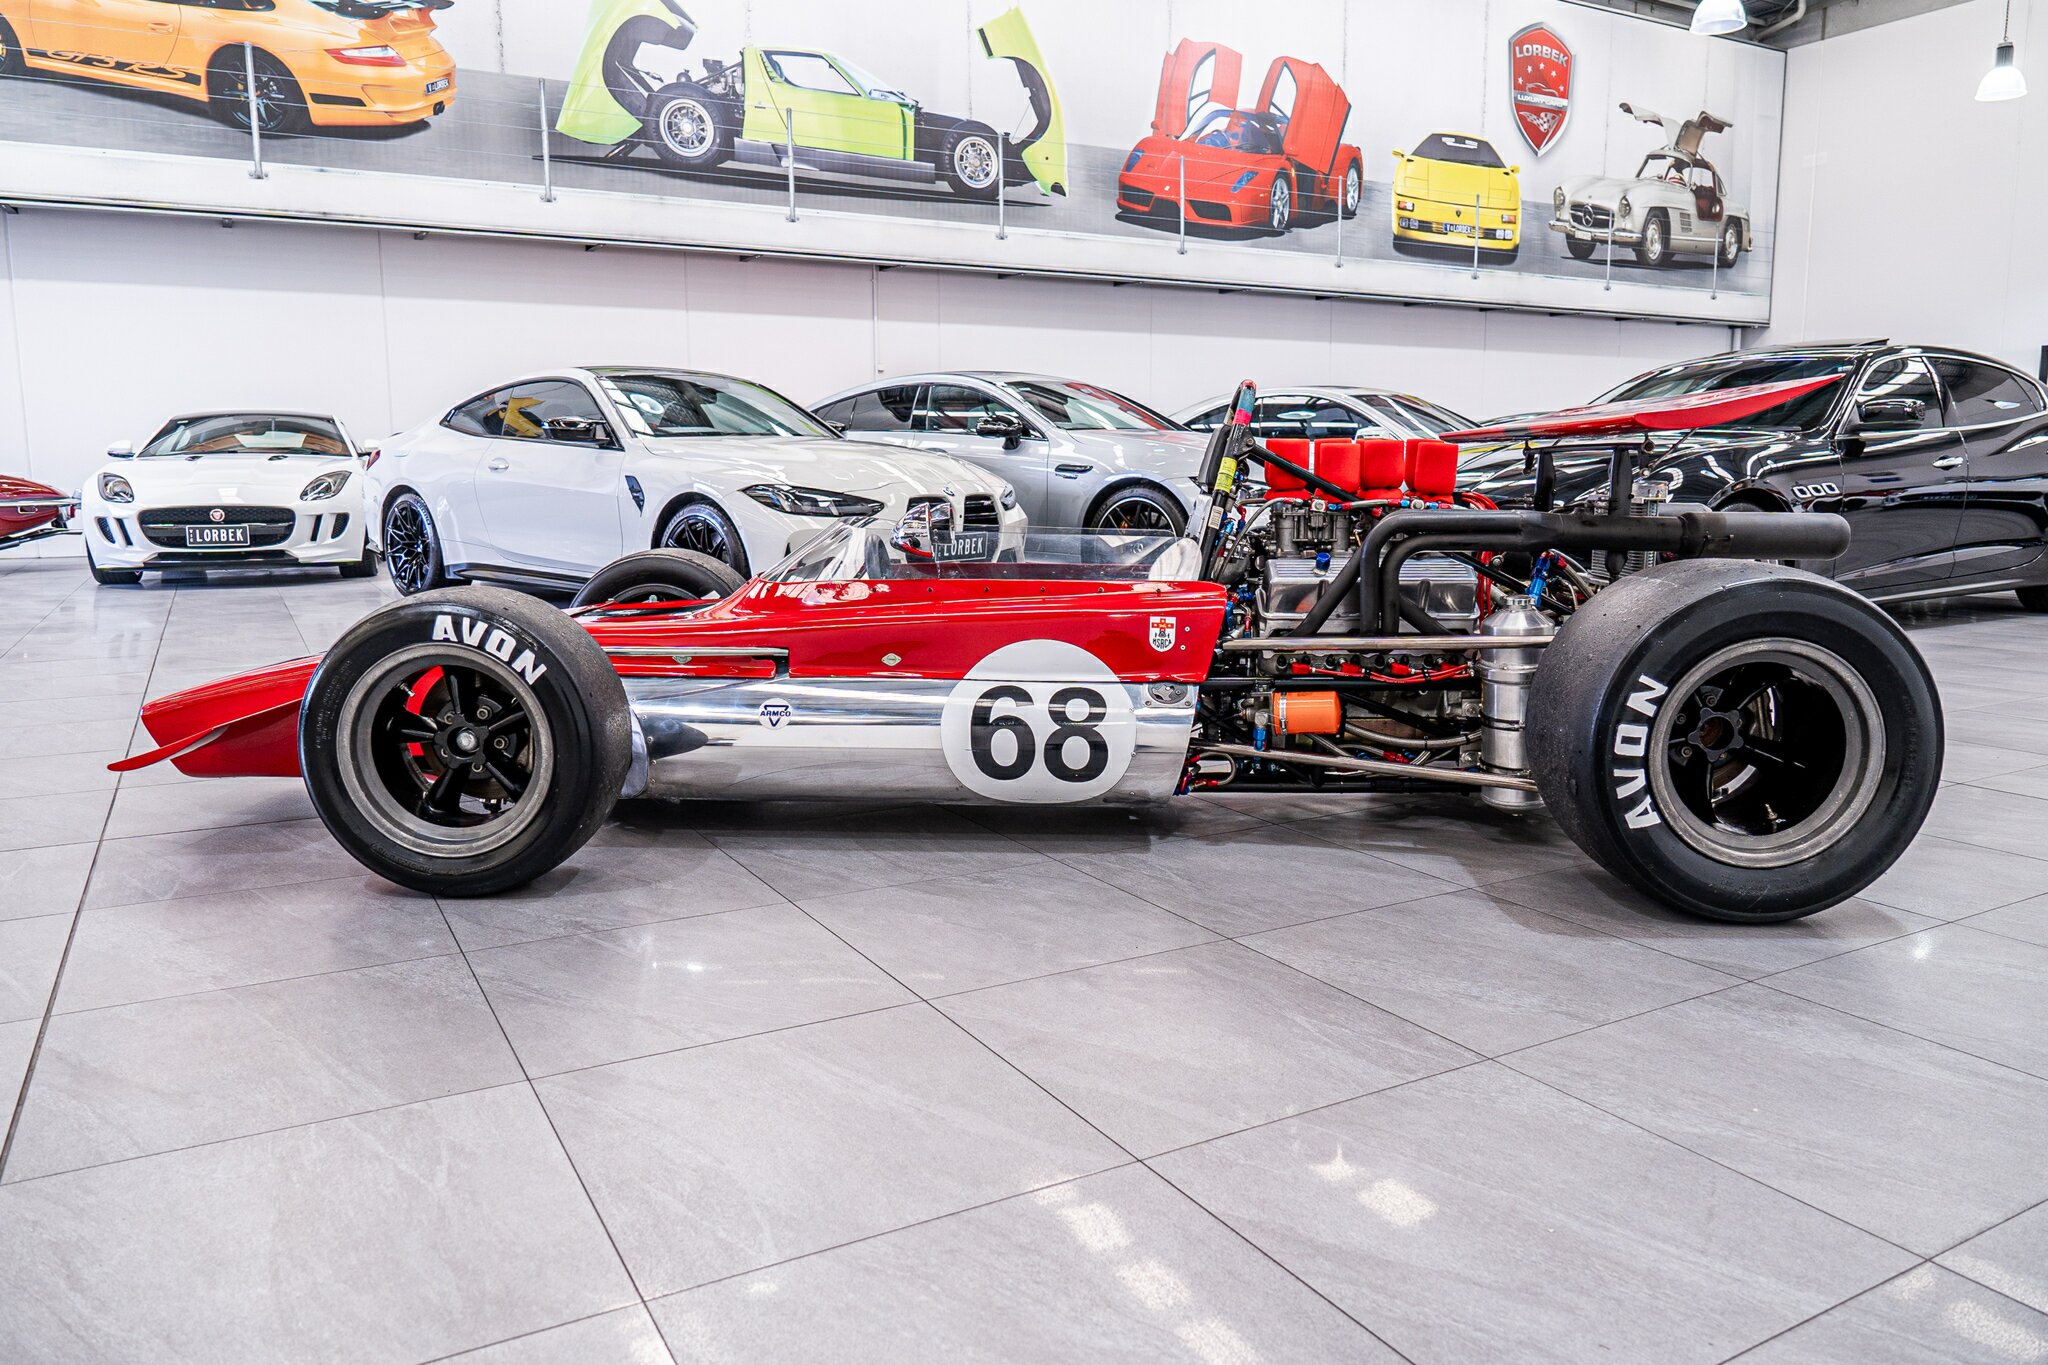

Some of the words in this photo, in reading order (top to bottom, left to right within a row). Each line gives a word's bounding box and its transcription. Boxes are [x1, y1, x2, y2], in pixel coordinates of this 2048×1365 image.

[1515, 44, 1568, 67] LORBEK
[1517, 94, 1544, 104] LUXURY
[1453, 224, 1472, 234] LORBEK
[195, 529, 244, 542] LORBEK
[943, 537, 984, 557] LORBEK
[432, 615, 547, 685] AVON
[970, 684, 1108, 783] 68
[1613, 674, 1668, 829] AVON
